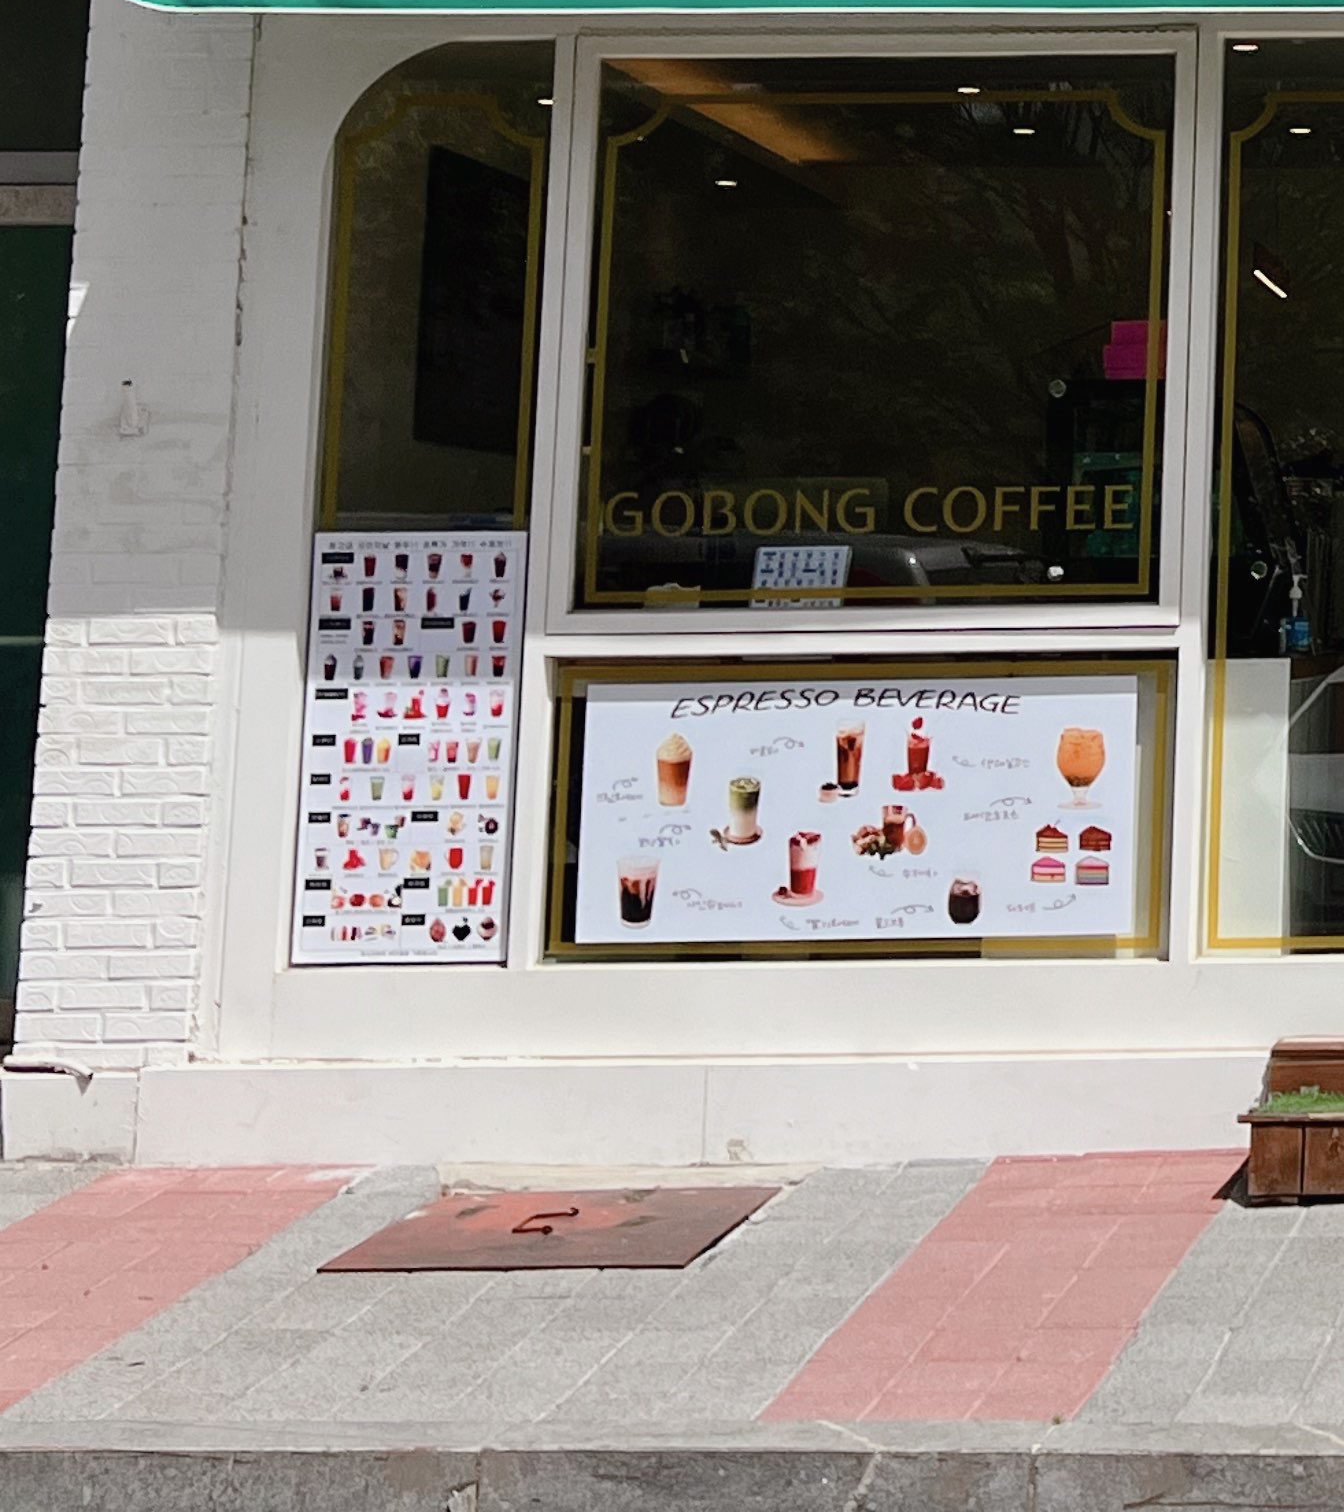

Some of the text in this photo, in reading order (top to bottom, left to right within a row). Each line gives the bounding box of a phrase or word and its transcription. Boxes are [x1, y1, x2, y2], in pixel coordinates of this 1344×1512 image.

[604, 486, 1134, 537] GOBONG COFFEE
[671, 687, 1022, 719] ESPRESSO BEVERAGE
